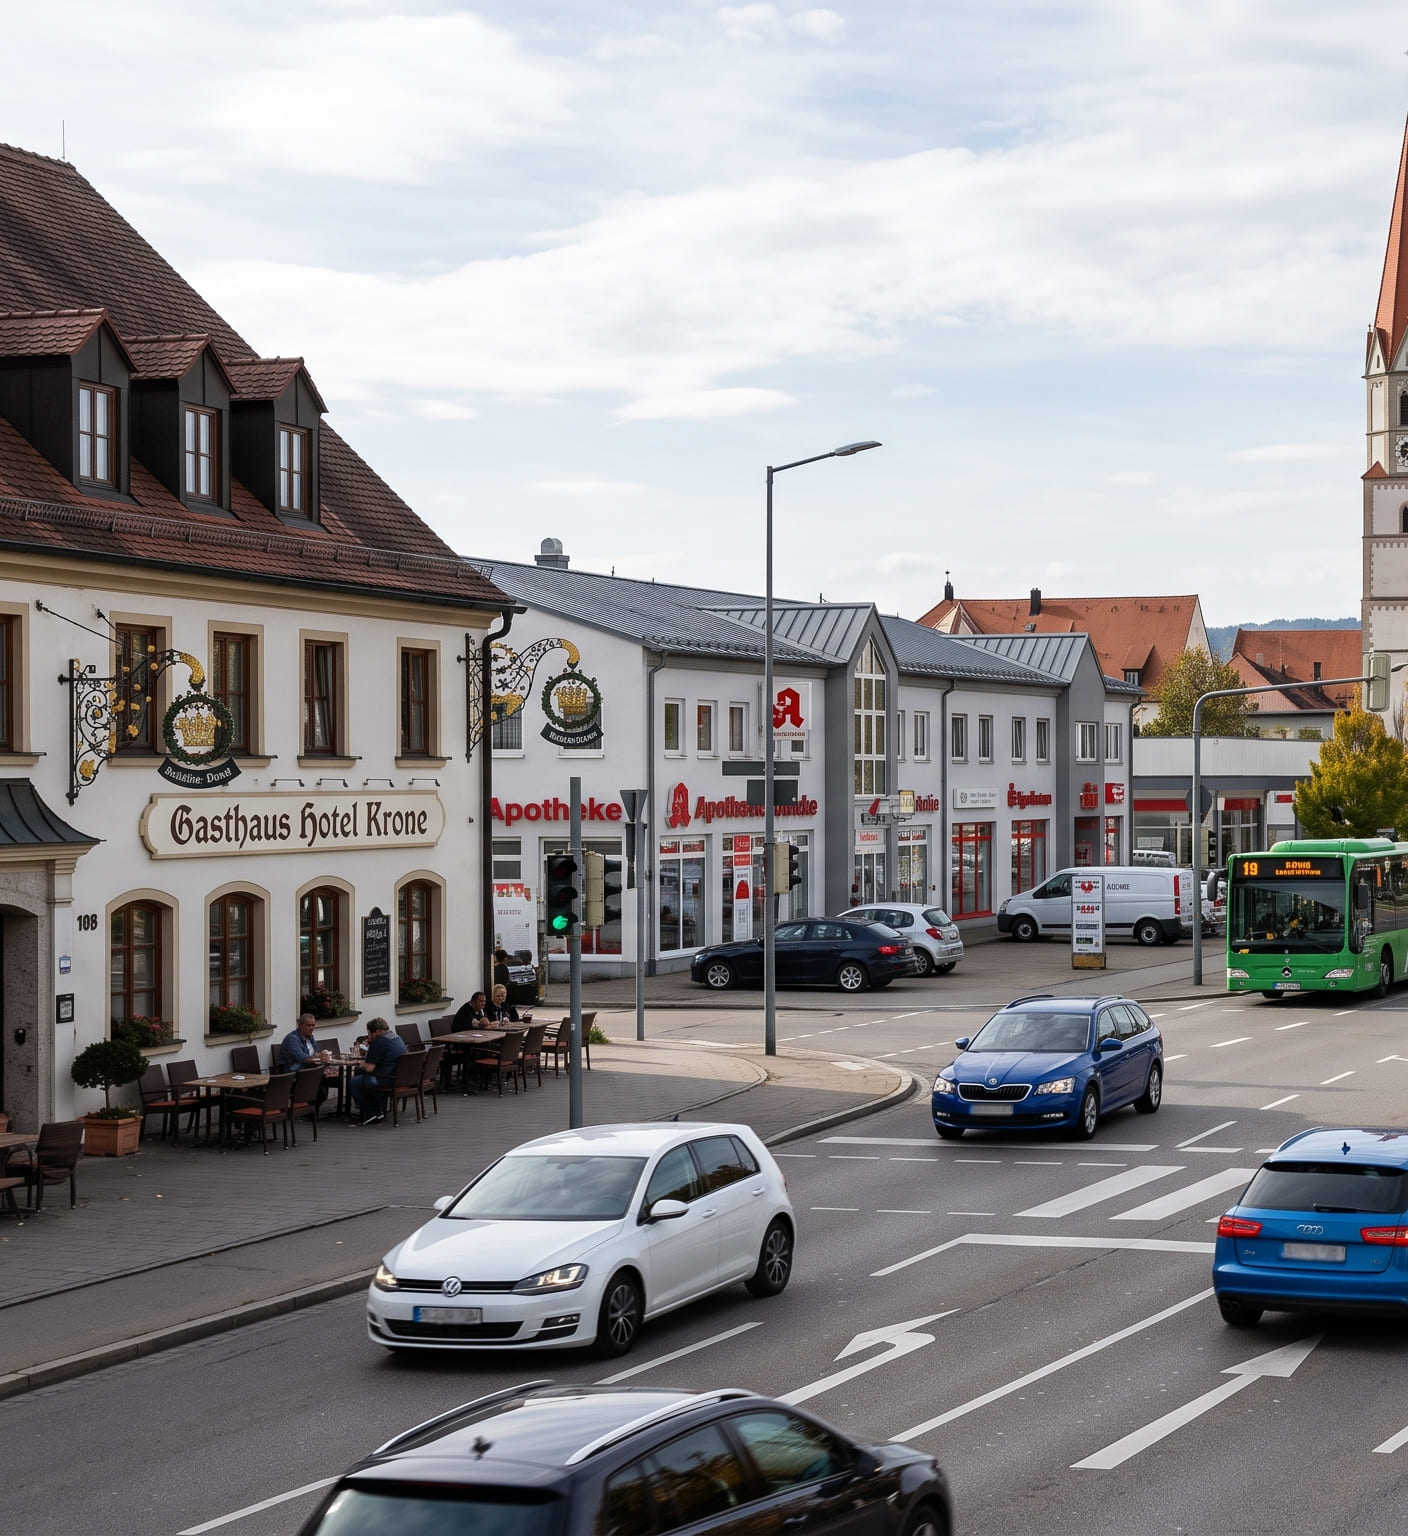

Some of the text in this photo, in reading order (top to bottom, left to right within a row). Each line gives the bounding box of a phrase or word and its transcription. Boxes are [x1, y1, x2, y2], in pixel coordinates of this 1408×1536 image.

[170, 801, 428, 850] Gasthaus Hotel Krone
[1242, 861, 1259, 876] 19
